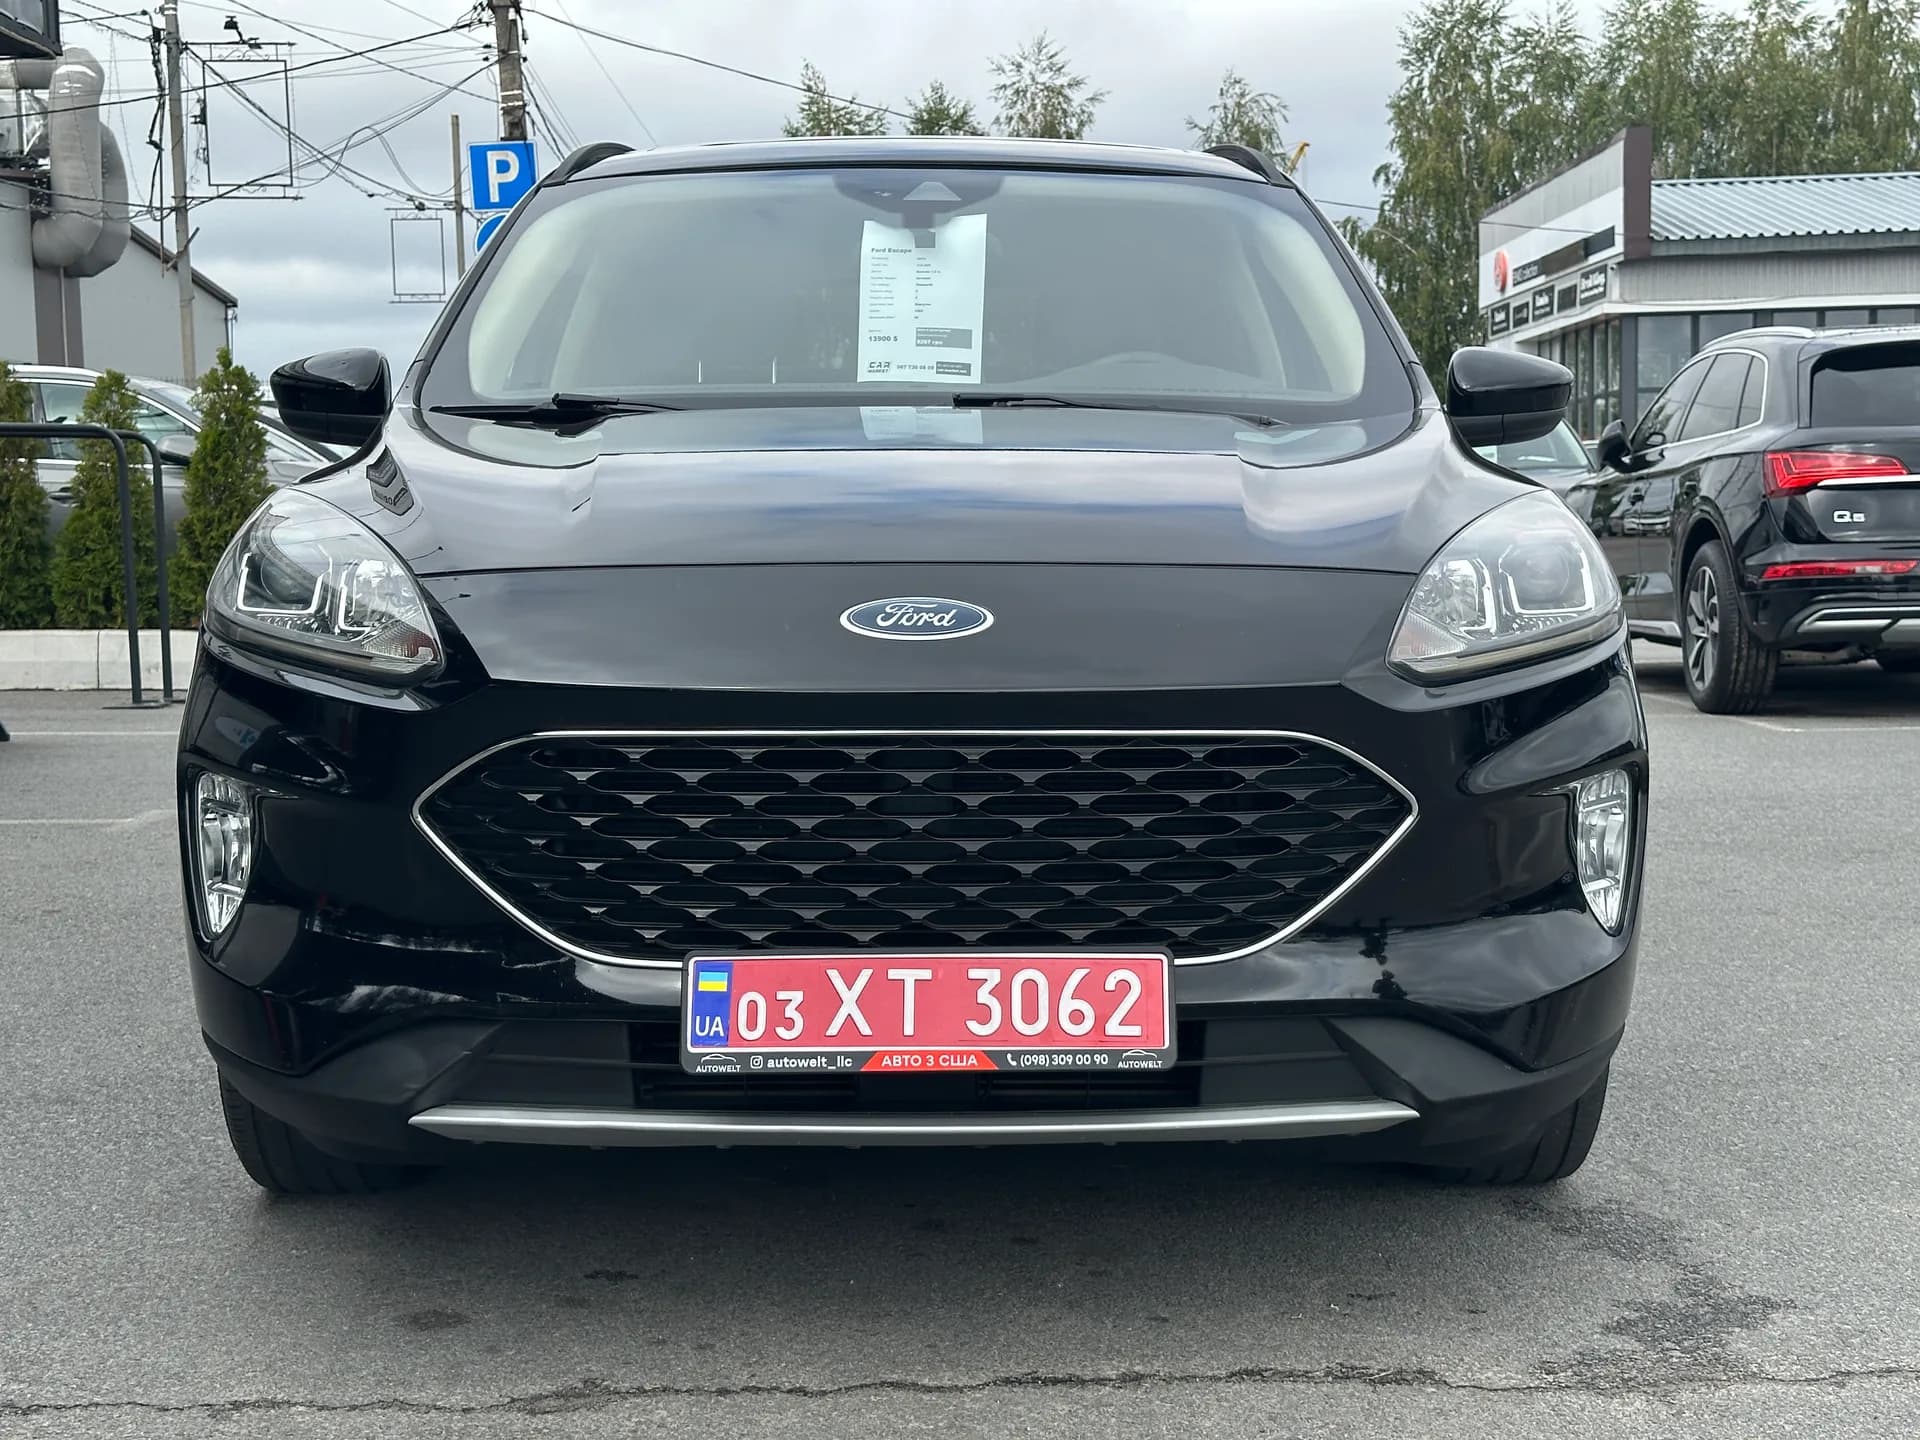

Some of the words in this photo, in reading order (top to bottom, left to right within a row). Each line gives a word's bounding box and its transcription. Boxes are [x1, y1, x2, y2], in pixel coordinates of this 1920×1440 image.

[486, 150, 520, 203] P
[876, 602, 958, 627] Ford
[736, 990, 805, 1041] 03
[964, 967, 1143, 1037] 3062
[695, 1015, 725, 1037] UA
[767, 1055, 853, 1070] autowelt_llc
[881, 1054, 922, 1067] АВТО
[939, 1054, 979, 1067] США
[1020, 1053, 1050, 1068] (098)
[1051, 1054, 1073, 1066] 309
[1075, 1053, 1091, 1066] 00
[1093, 1053, 1109, 1066] 90
[1117, 1060, 1163, 1069] AUTOWELT
[695, 1064, 741, 1073] AUTOWELT
